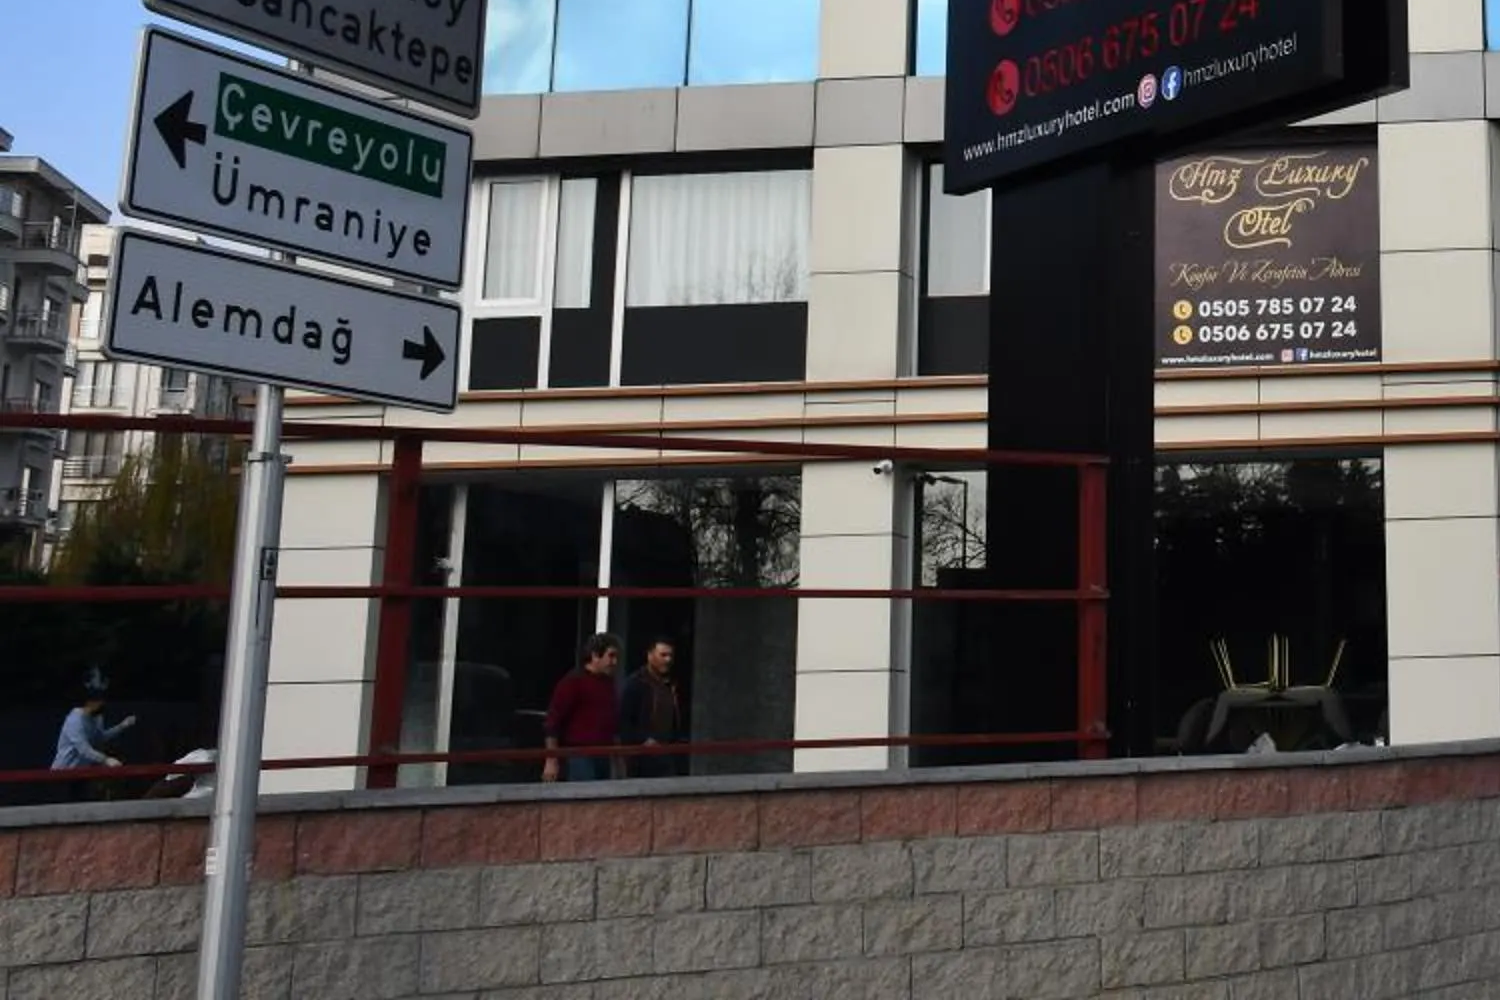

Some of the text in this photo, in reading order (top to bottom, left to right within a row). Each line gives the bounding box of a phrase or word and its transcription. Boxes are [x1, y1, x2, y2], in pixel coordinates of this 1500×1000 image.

[1024, 35, 1094, 96] 0506
[1103, 12, 1159, 69] 675
[220, 82, 442, 184] Çevreyolu
[963, 32, 1298, 161] www.hmzluxuryhotel.com hmzluxuryhotel
[211, 152, 432, 259] Ümraniye
[1169, 151, 1368, 204] Hmz Luxury
[1223, 197, 1315, 249] Otel
[131, 275, 354, 364] Alemdağ
[1199, 295, 1357, 318] 0505 785 07 24
[1199, 321, 1357, 343] 0506 675 07 24
